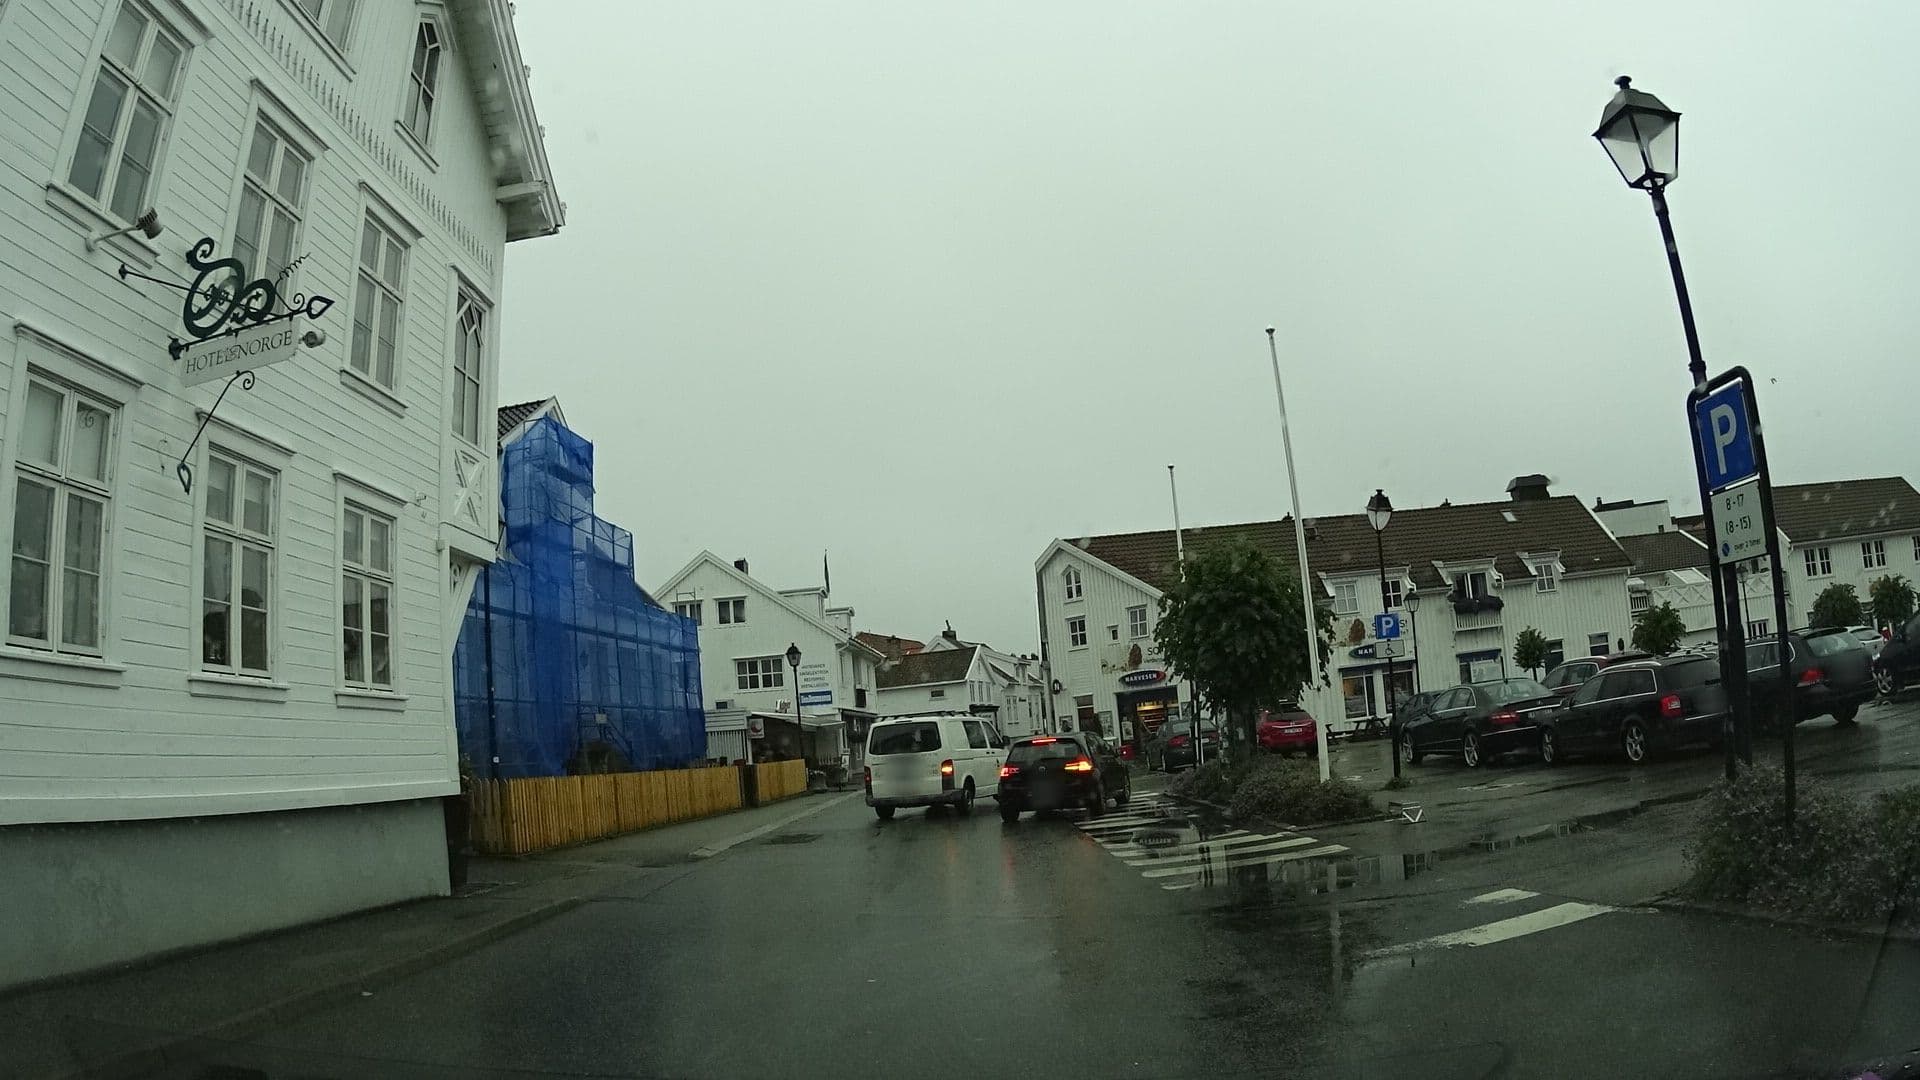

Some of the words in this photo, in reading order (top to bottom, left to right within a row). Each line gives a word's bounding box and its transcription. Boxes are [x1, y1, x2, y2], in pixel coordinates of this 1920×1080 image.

[234, 330, 293, 359] NORGE
[1710, 403, 1737, 475] P
[1382, 617, 1394, 636] P
[1125, 674, 1157, 682] NARVESEN
